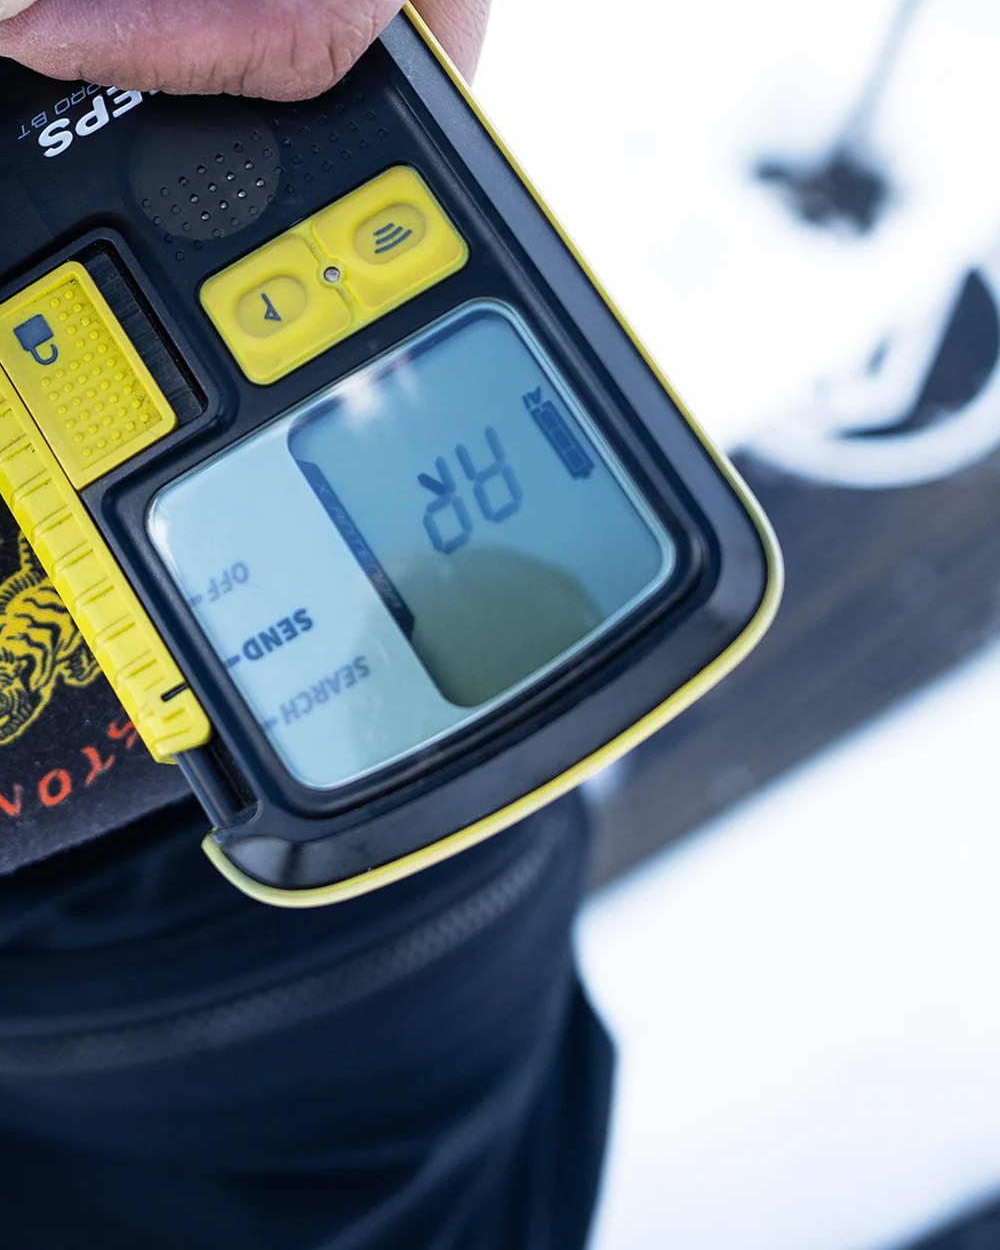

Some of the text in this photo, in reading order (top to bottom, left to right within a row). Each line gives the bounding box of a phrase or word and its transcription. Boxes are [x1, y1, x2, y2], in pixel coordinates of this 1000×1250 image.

[17, 111, 48, 140] BT
[38, 85, 160, 158] EPS
[417, 424, 523, 555] AR
[206, 562, 250, 603] OFF
[241, 608, 315, 661] SEND
[278, 655, 371, 726] SEARCH
